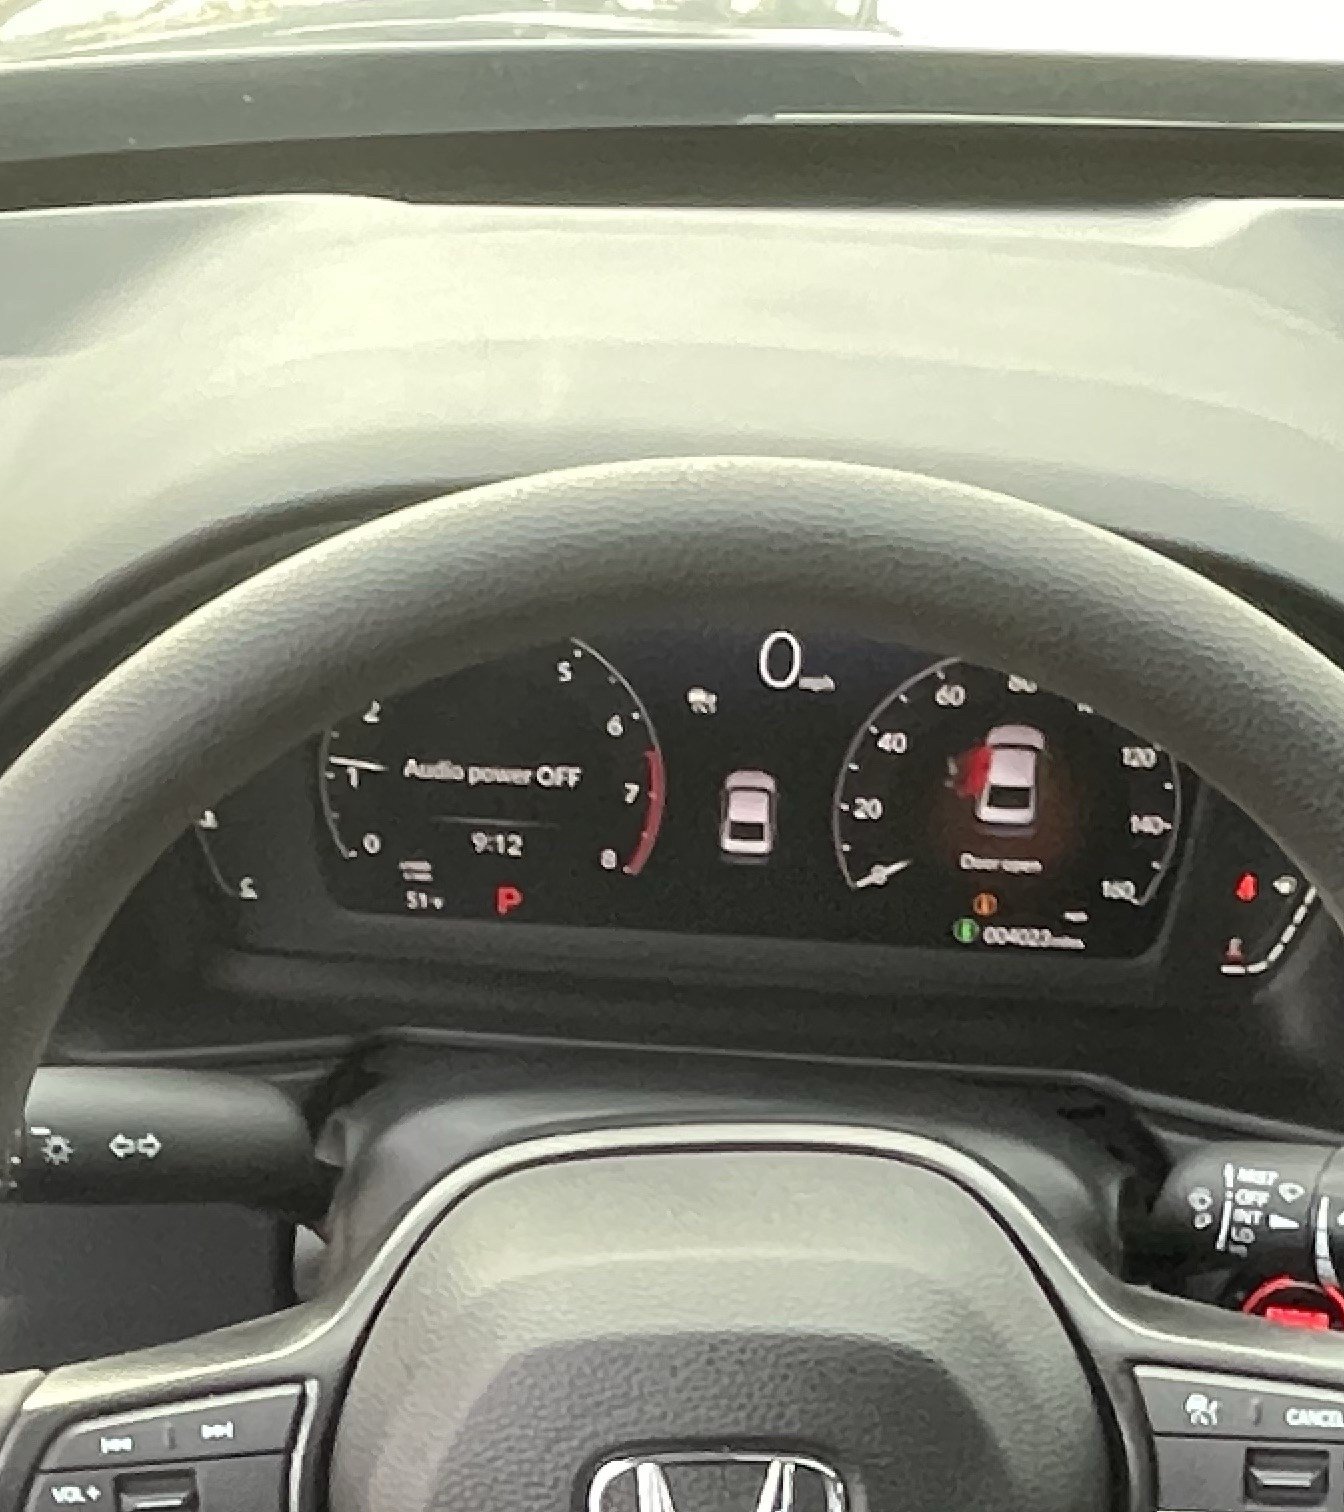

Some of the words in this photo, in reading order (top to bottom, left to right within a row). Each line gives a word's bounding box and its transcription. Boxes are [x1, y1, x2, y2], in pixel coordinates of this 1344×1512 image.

[759, 630, 802, 689] 0
[558, 662, 572, 682] 5
[935, 685, 965, 707] 60
[606, 716, 624, 737] 6
[877, 732, 908, 754] 40
[1121, 746, 1156, 768] 120
[467, 765, 532, 788] power
[535, 766, 582, 790] OFF
[623, 783, 639, 804] 7
[853, 799, 883, 820] 20
[363, 833, 381, 855] 0
[471, 831, 523, 857] 9:12
[497, 887, 523, 916] P
